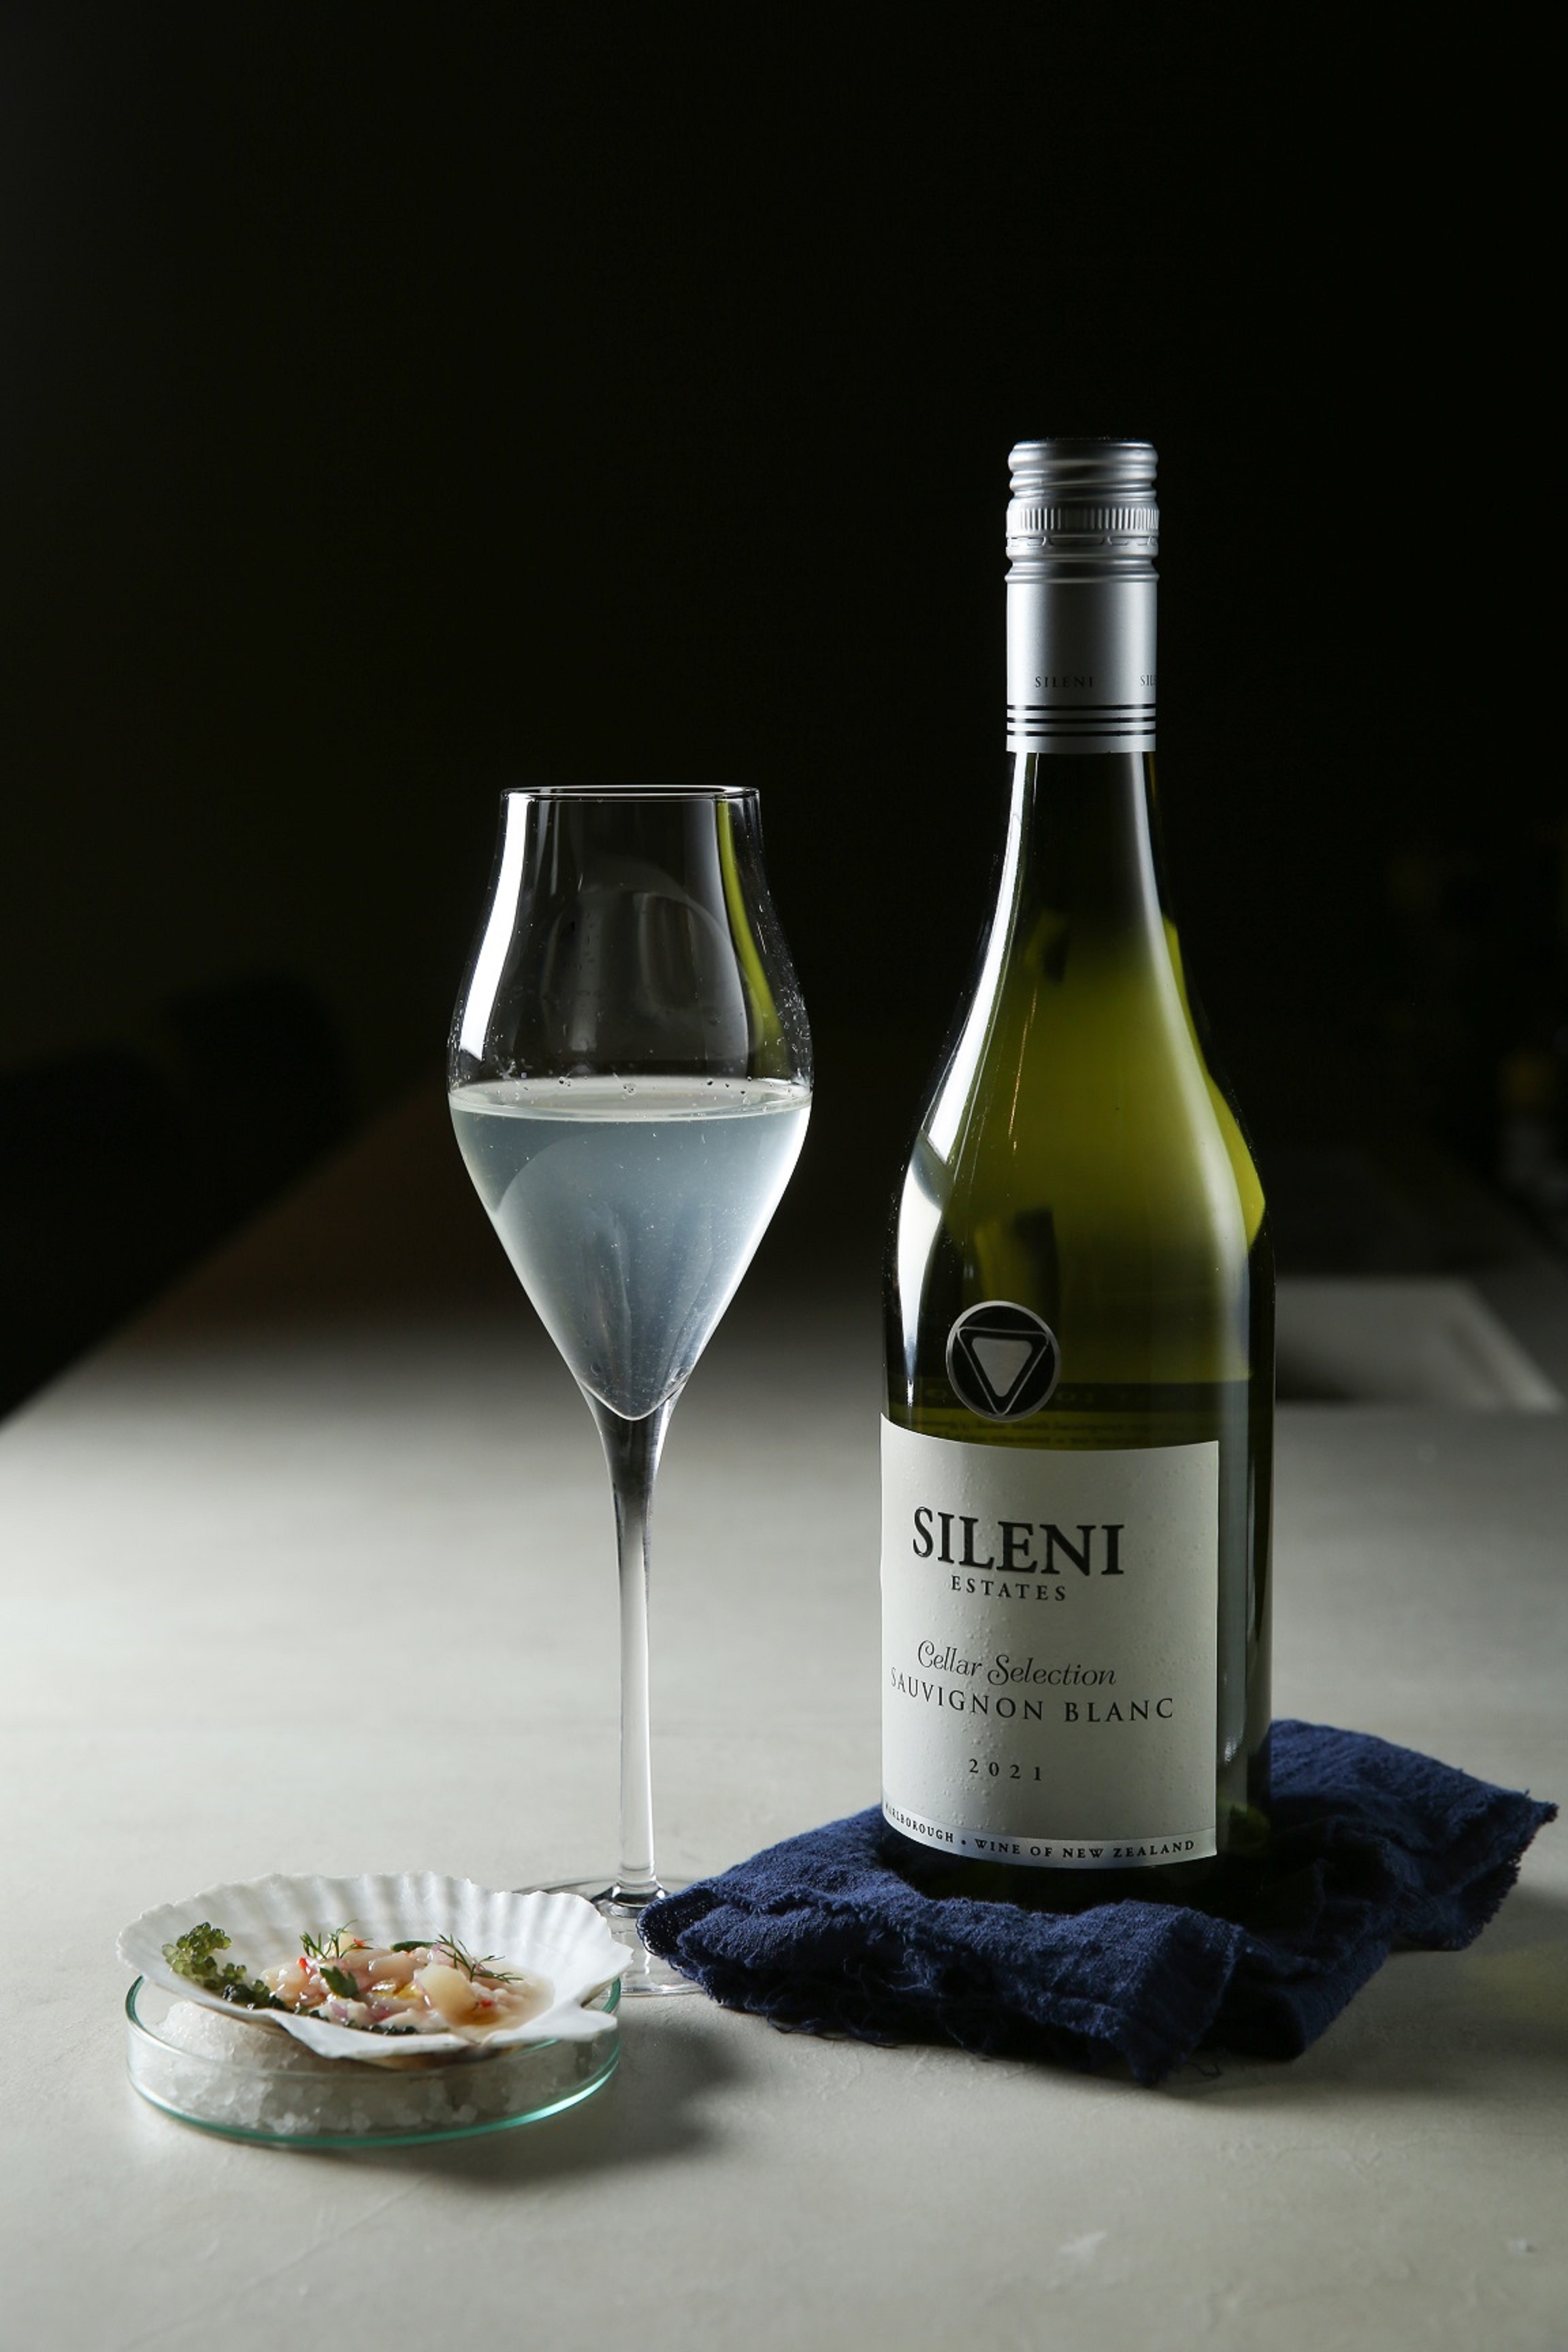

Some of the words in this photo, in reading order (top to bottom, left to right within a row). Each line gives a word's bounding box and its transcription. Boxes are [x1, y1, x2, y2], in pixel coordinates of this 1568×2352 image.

[1034, 676, 1094, 688] SILENI
[913, 1506, 1125, 1576] SILENI
[951, 1575, 1066, 1601] ESTATES
[917, 1640, 982, 1677] Cellar
[987, 1654, 1117, 1686] Selection
[890, 1667, 1043, 1721] SAUVIGNON
[1064, 1698, 1174, 1722] BLANC
[968, 1758, 1042, 1782] 2021
[975, 1839, 1020, 1855] WINE
[1030, 1846, 1053, 1857] OF
[1062, 1847, 1104, 1859] NEW
[1113, 1840, 1194, 1858] ZEALAND
